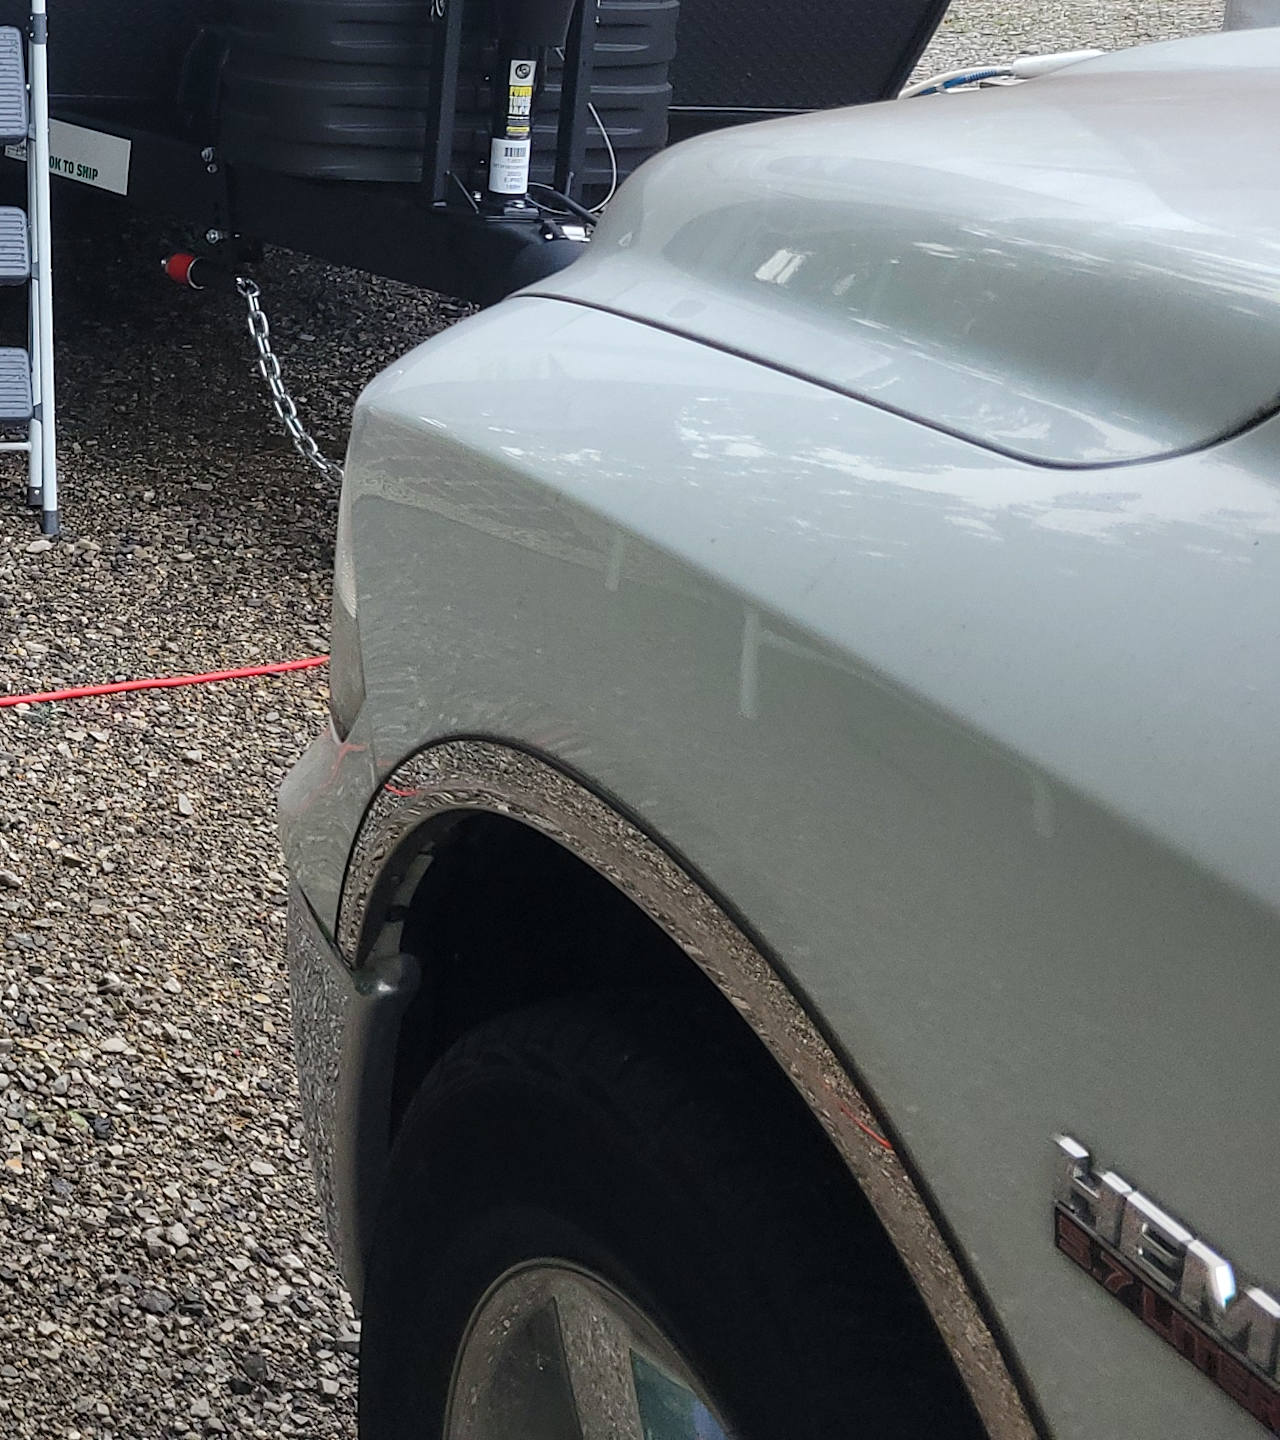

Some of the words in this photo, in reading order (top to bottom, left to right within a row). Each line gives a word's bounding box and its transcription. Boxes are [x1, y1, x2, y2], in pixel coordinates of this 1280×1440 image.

[48, 155, 62, 171] OK
[63, 159, 74, 175] TO
[76, 163, 99, 181] SHIP
[1050, 1133, 1280, 1382] HEM
